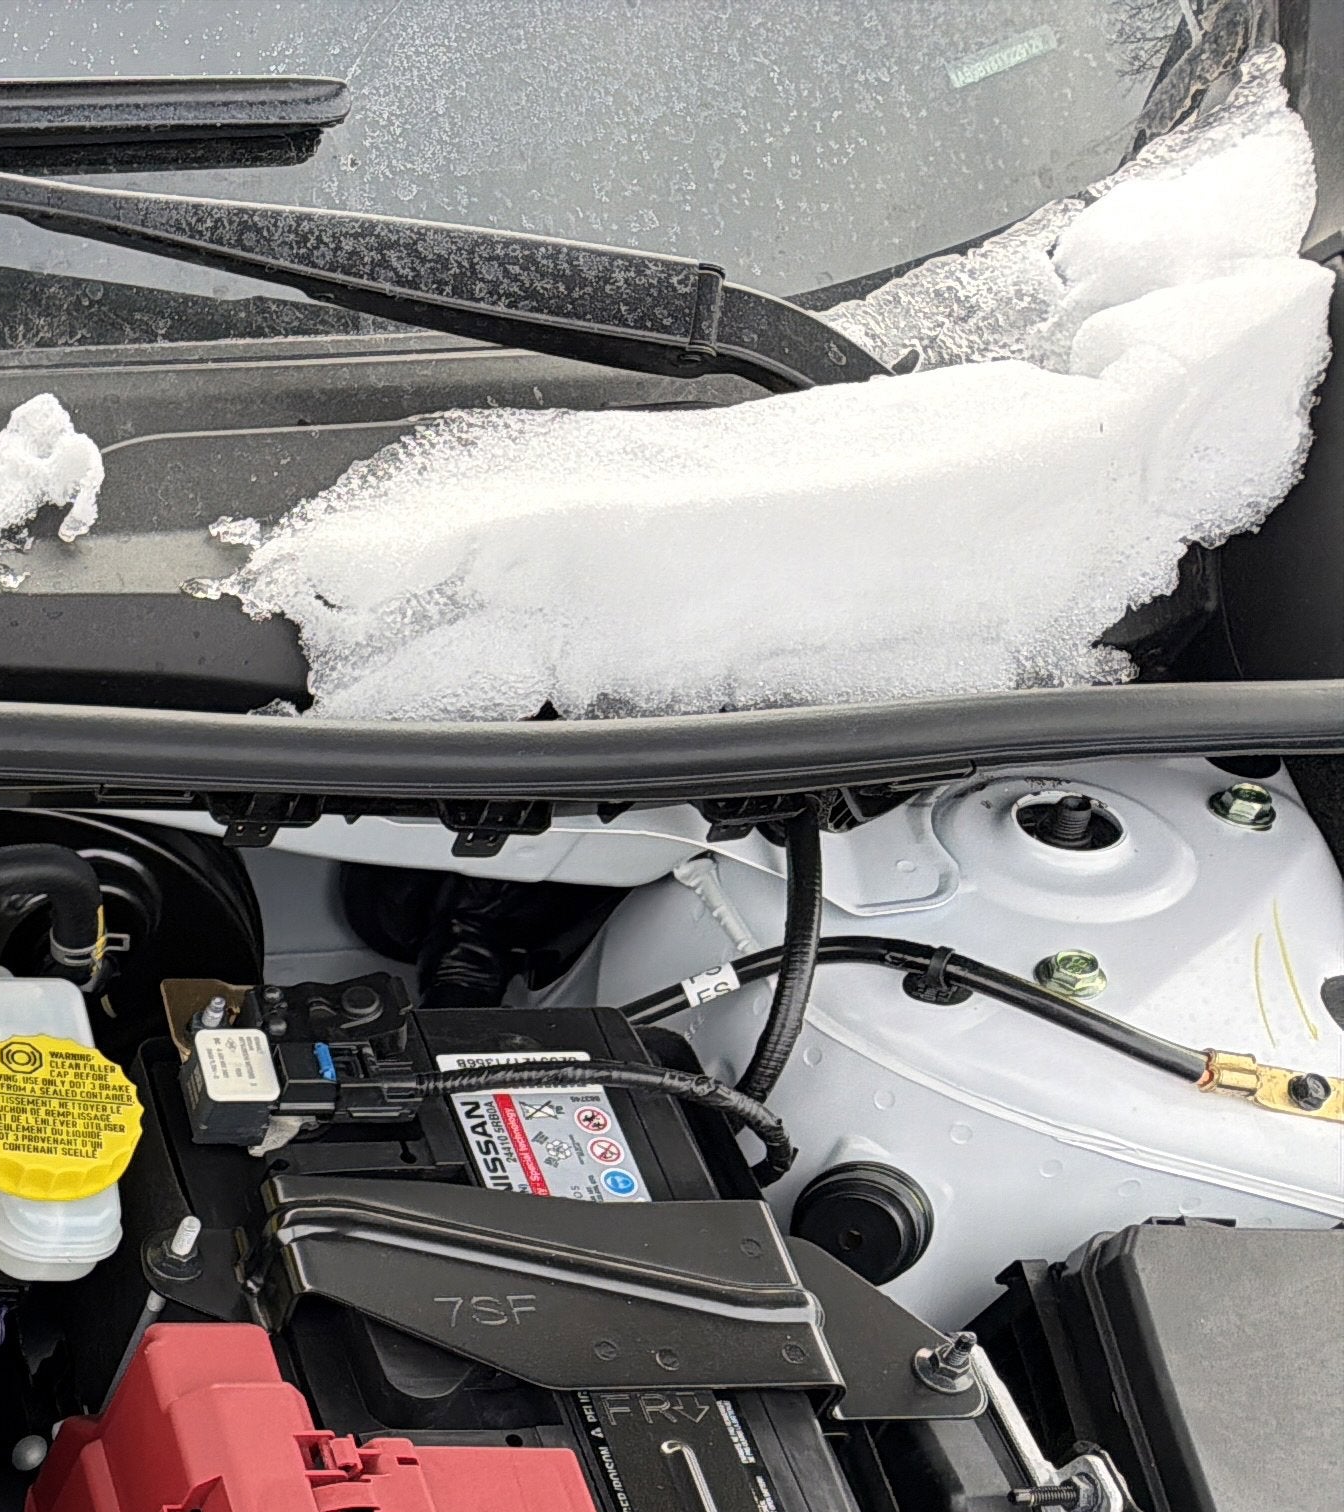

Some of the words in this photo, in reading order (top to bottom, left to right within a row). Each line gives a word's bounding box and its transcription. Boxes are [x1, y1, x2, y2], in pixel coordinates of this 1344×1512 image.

[49, 1060, 81, 1071] CLEAN
[81, 1063, 115, 1073] FILLER
[49, 1069, 70, 1079] CAP
[73, 1071, 109, 1082] BEFORE
[0, 1082, 26, 1092] FROM
[29, 1085, 36, 1094] A
[39, 1086, 77, 1098] SEALED
[21, 1076, 40, 1085] USE
[40, 1077, 68, 1088] ONLY
[68, 1080, 86, 1090] DOT
[89, 1081, 95, 1090] 3
[97, 1082, 130, 1093] BRAKE
[29, 1107, 42, 1117] DE
[44, 1108, 112, 1123] REMPLISSAGE
[58, 1101, 108, 1113] NETTOYER
[109, 1105, 122, 1115] LE
[10, 1114, 23, 1124] DE
[51, 1126, 64, 1137] DU
[66, 1128, 102, 1140] LIQUIDE
[503, 1106, 528, 1151] technology
[12, 1133, 19, 1142] 3
[21, 1134, 79, 1147] PROVENANT
[2, 1141, 58, 1155] CONTENANT
[519, 1150, 540, 1183] Special
[432, 1289, 536, 1331] 7SF
[598, 1390, 678, 1427] FR
